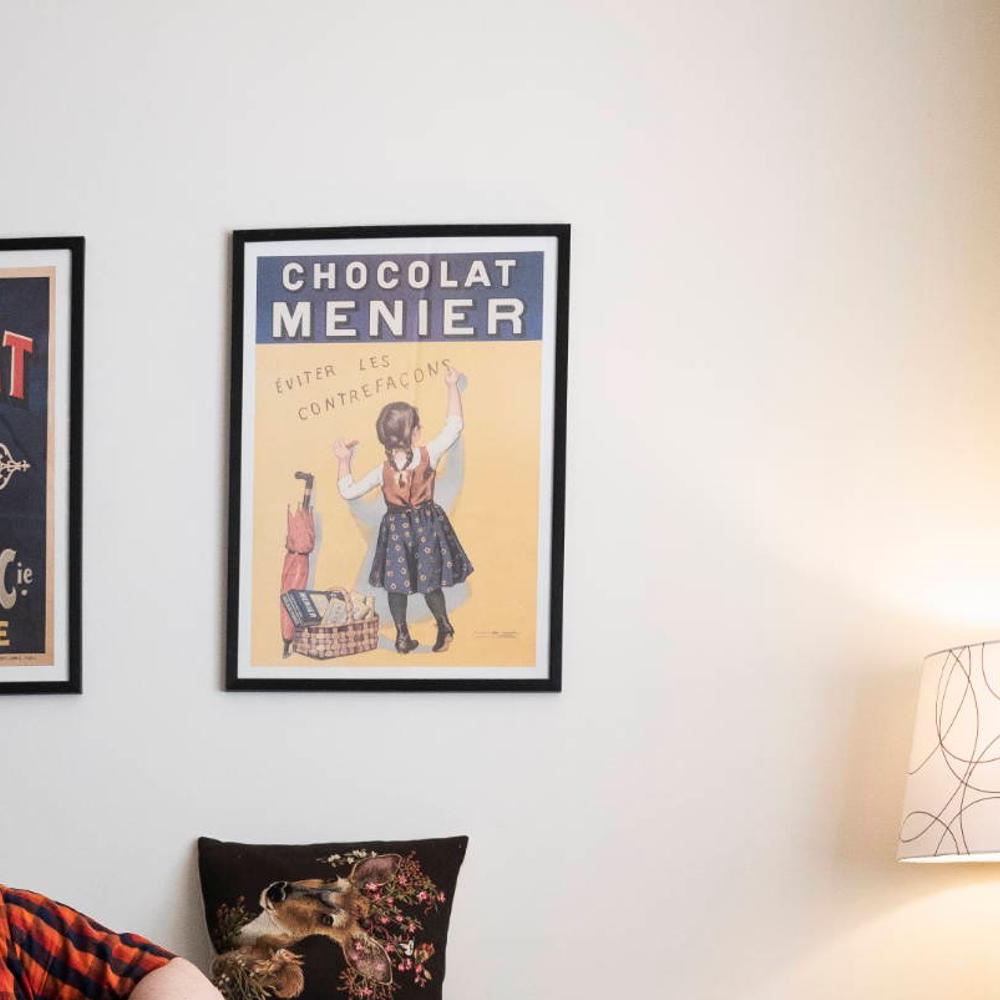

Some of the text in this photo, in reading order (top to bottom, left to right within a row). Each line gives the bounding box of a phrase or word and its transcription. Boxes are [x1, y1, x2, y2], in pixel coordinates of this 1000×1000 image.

[282, 259, 517, 291] CHOCOLAT
[272, 298, 525, 338] MENIER
[359, 354, 391, 371] LES
[297, 358, 452, 421] CONTREFAÇONS
